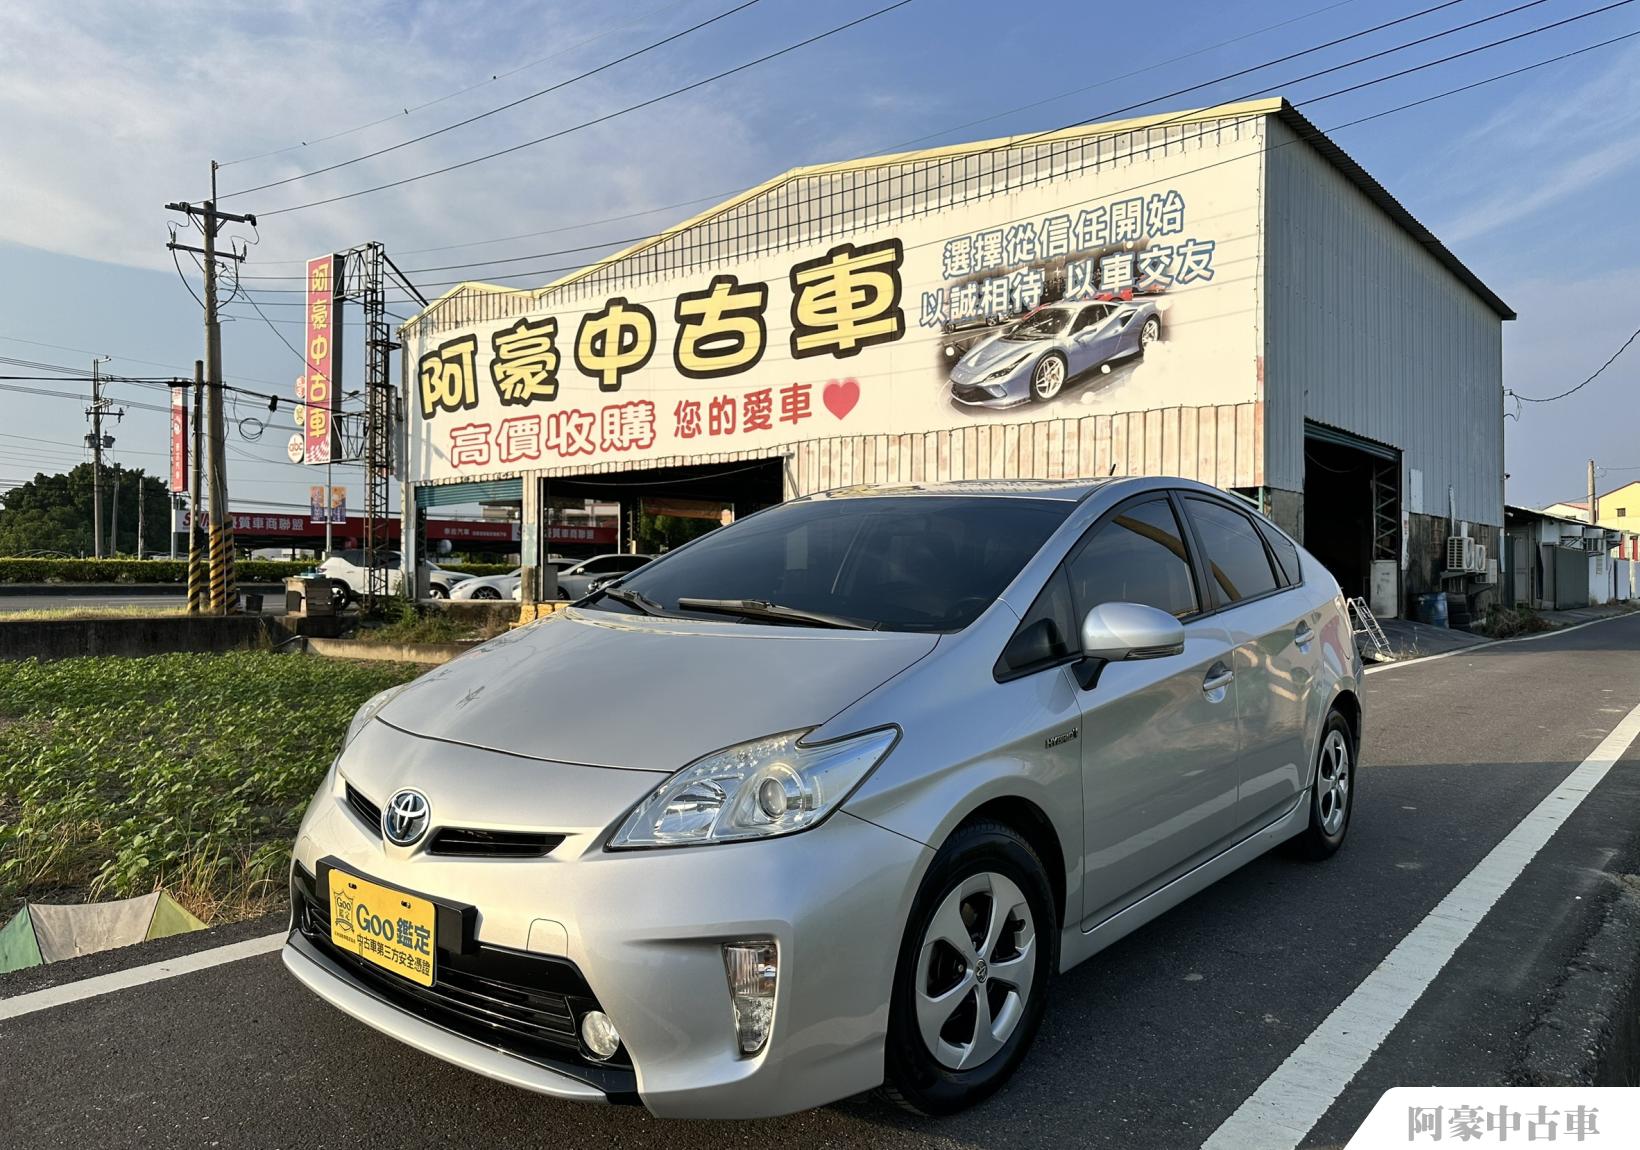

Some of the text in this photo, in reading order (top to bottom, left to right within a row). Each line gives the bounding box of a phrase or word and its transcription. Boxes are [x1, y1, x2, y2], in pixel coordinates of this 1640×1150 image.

[943, 190, 1185, 280] 選擇從信任開始
[419, 238, 905, 419] 阿豪中古車
[920, 240, 1215, 328] 以誠相待 以車交友
[310, 262, 329, 439] 阿豪中古車
[450, 382, 813, 468] 高價收購 您的愛車
